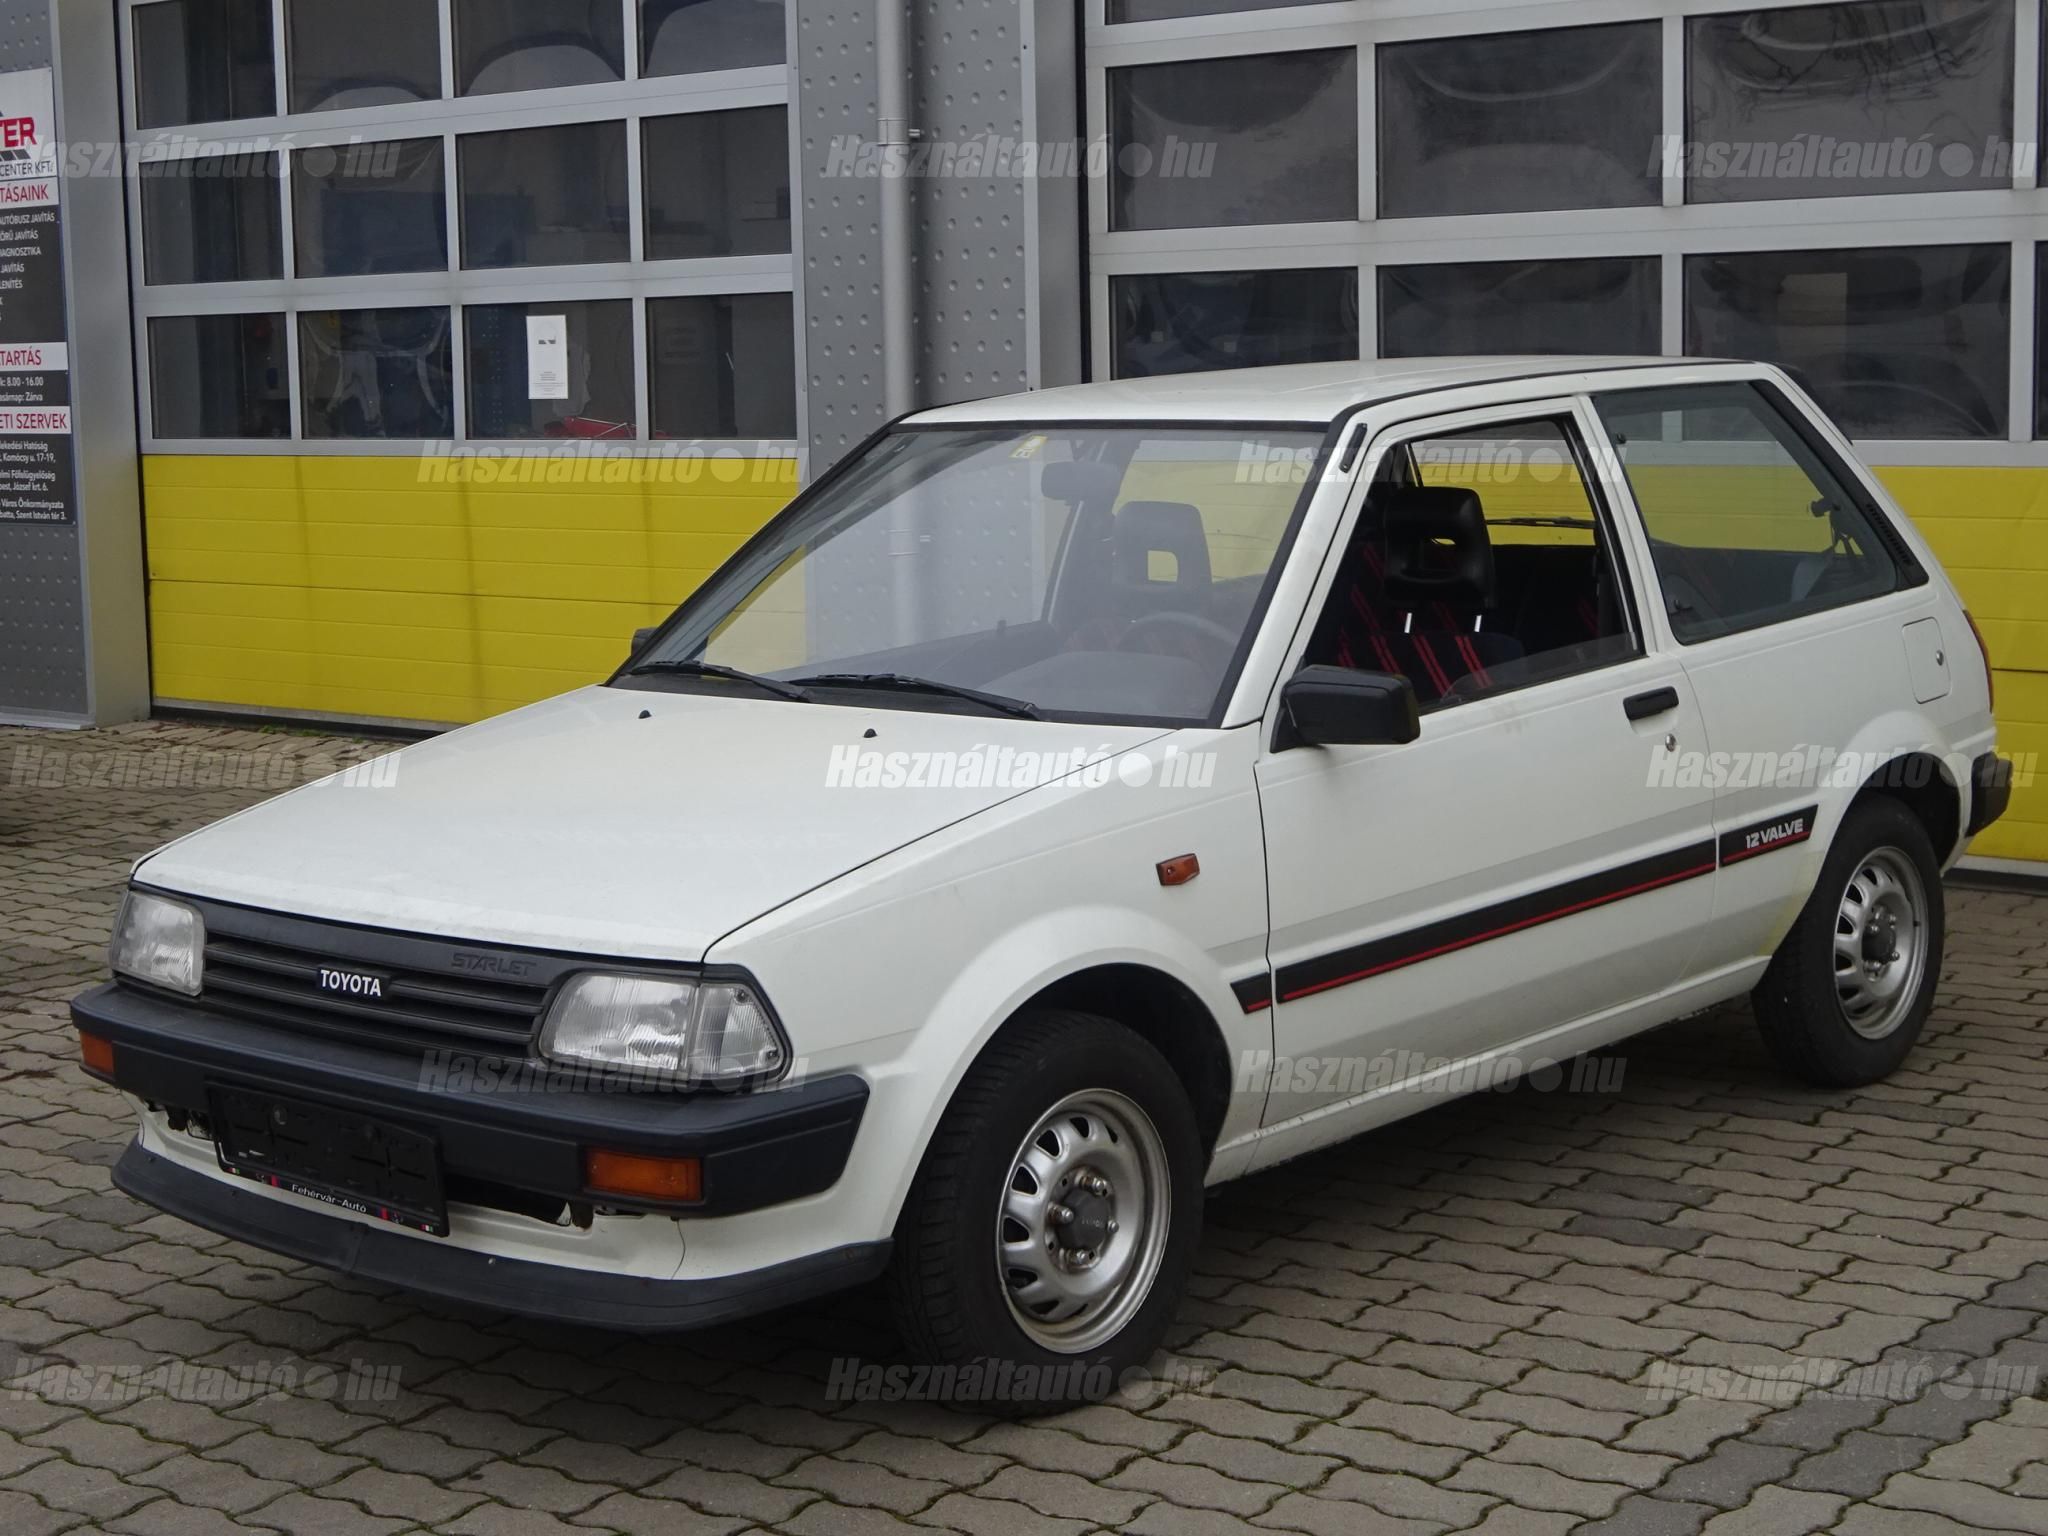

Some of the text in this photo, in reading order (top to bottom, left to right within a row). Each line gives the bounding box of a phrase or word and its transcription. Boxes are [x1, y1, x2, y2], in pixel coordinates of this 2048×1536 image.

[0, 212, 30, 224] UTÓBUSZ
[16, 413, 68, 429] SZERVEK
[451, 952, 537, 977] STARLET
[320, 969, 382, 997] TOYOTA
